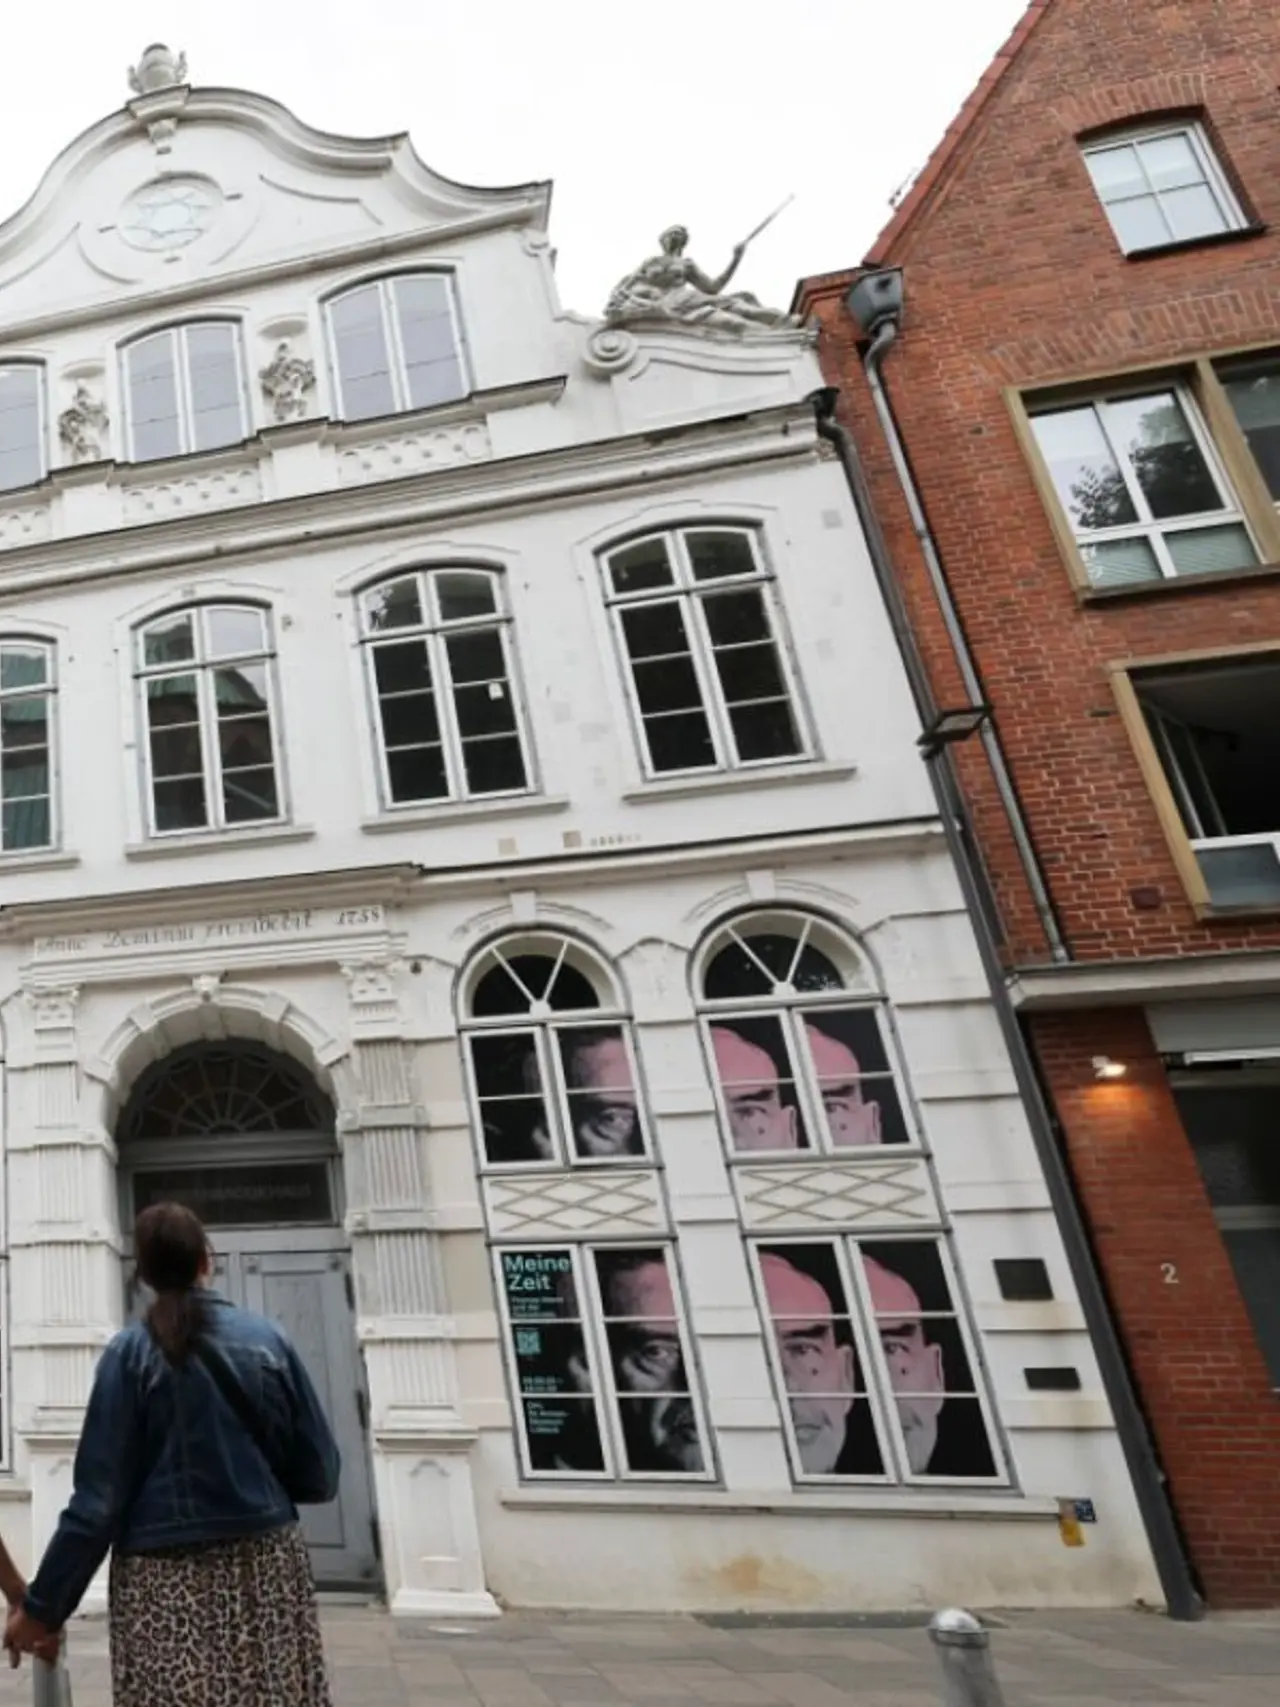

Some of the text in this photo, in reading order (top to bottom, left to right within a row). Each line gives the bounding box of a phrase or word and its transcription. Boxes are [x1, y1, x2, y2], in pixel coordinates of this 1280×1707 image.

[504, 1253, 570, 1273] Meine
[1160, 1262, 1180, 1284] 2
[507, 1272, 552, 1291] Zeit
